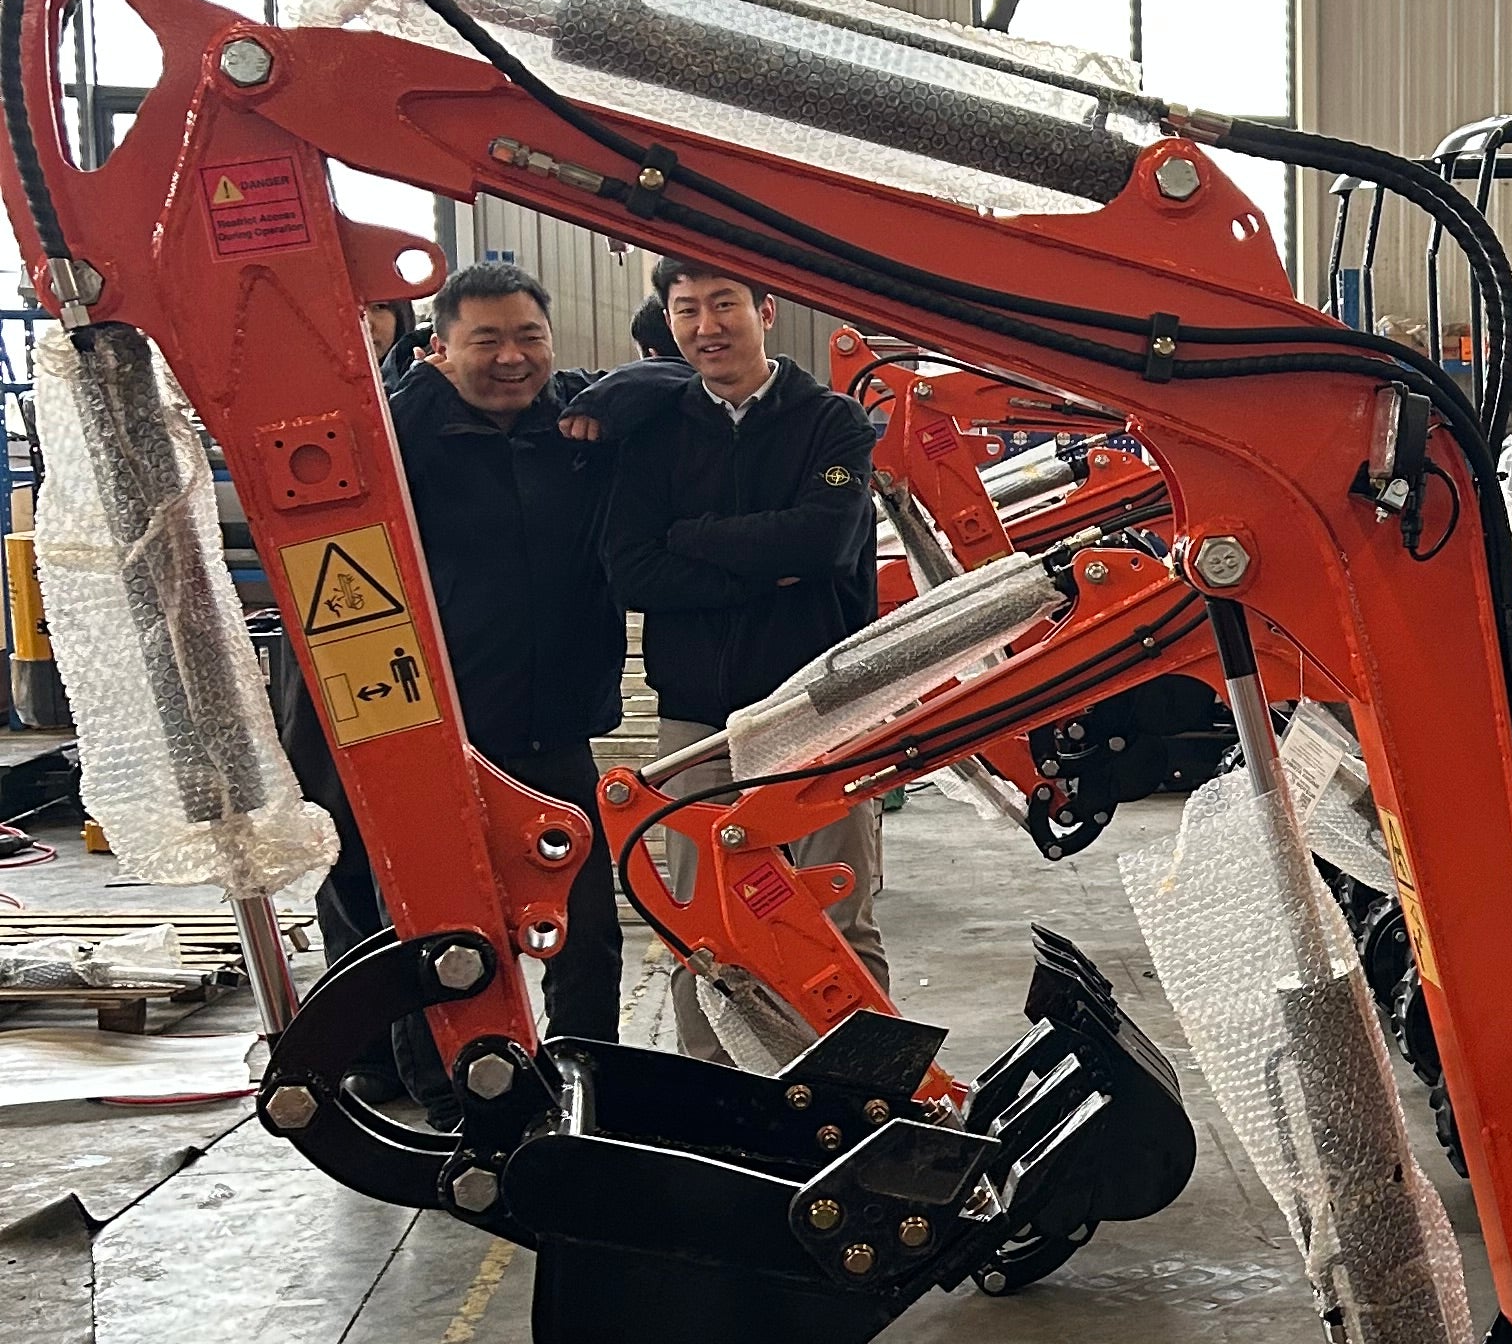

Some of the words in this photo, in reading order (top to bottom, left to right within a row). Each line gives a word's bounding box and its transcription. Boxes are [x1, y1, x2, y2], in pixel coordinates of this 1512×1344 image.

[240, 175, 290, 191] DANGER
[216, 216, 257, 229] Restrict
[260, 212, 296, 223] Access
[218, 231, 253, 242] During
[254, 223, 305, 237] Operation
